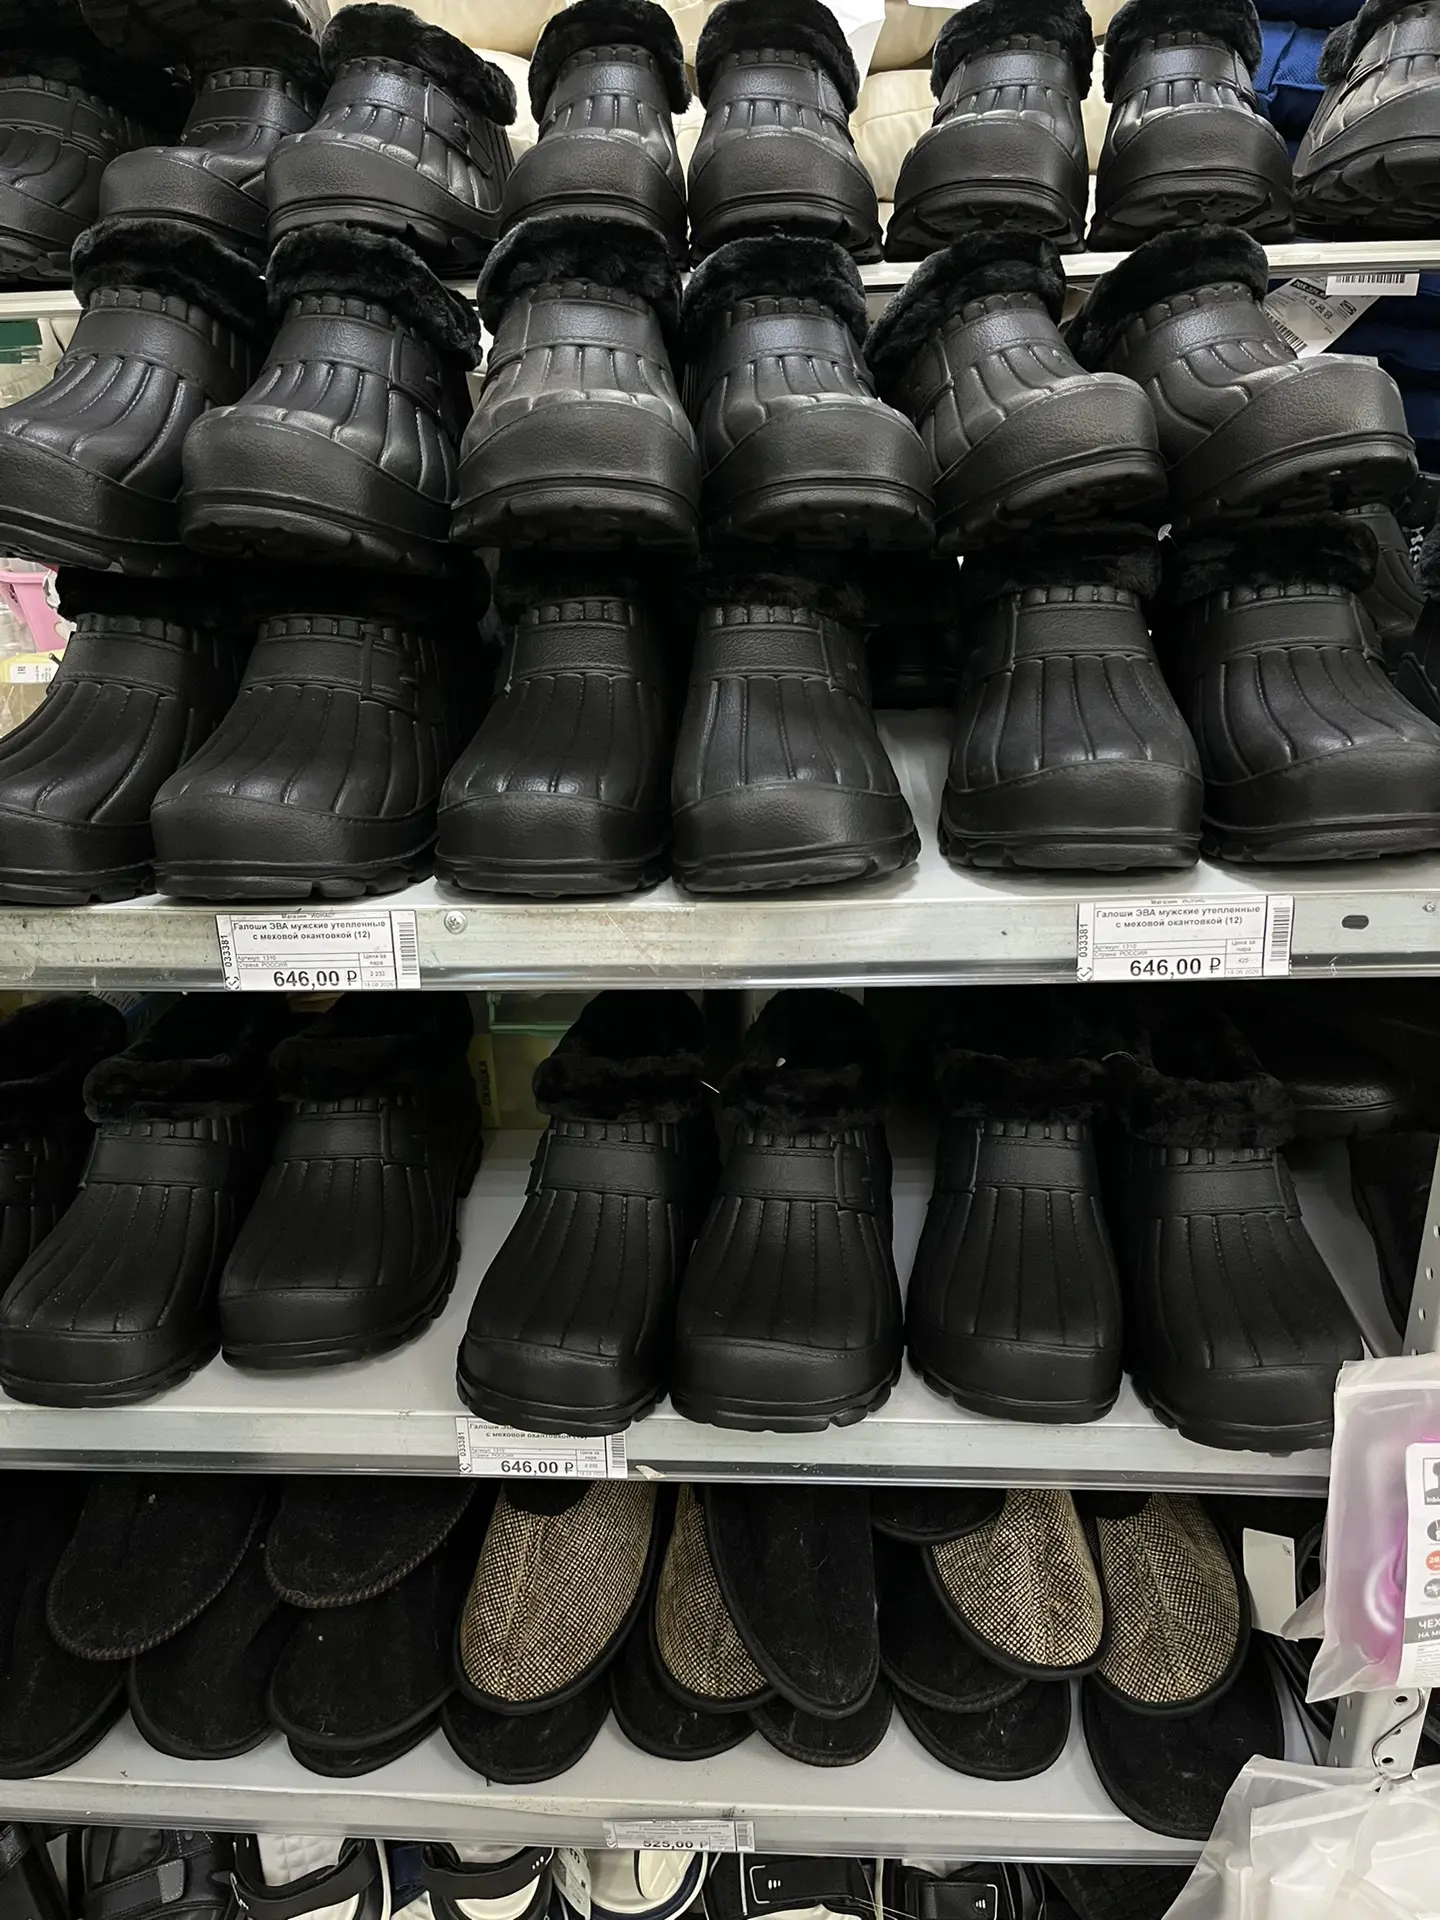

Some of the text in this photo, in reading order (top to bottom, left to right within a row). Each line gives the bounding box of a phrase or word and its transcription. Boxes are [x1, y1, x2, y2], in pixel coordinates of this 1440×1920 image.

[1096, 906, 1261, 918] Галоши ЭВА мужские утепленные
[233, 920, 386, 931] Галоши ЭВА мужские утепленные
[1123, 919, 1165, 928] меховой
[1167, 917, 1222, 927] окантовкой
[1224, 916, 1243, 926] (12)
[260, 932, 298, 940] меховой
[300, 931, 352, 939] окантовкой
[353, 930, 371, 940] (12)
[1078, 923, 1089, 958] 033381
[220, 934, 233, 968] 033381
[1129, 957, 1202, 979] 646,00
[273, 970, 340, 991] 646,00
[500, 1460, 558, 1476] 646,00
[643, 1840, 694, 1850] 525,00
